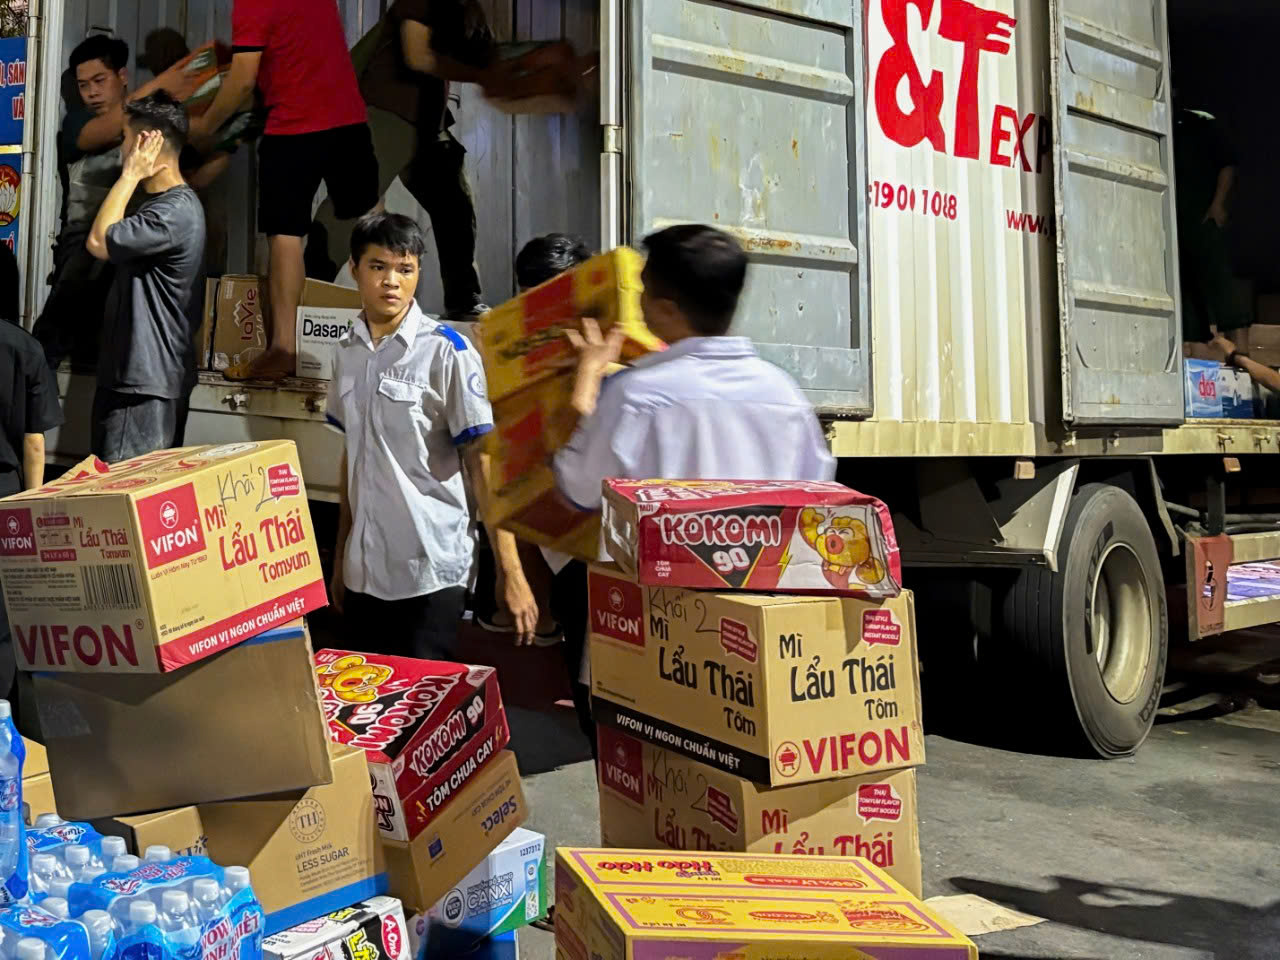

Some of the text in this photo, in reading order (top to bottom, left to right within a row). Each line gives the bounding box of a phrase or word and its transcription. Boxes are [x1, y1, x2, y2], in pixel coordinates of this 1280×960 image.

[303, 318, 350, 339] Dasan
[1, 536, 32, 550] VIFON
[101, 528, 128, 546] Thái
[150, 525, 198, 556] VIFON
[219, 508, 305, 571] Lẩu Thái
[661, 515, 781, 546] KOKOMI
[258, 549, 311, 584] Tomyum
[713, 548, 750, 575] 90
[189, 596, 305, 655] VIFON VỊ NGON CHUẨN VIỆT
[597, 610, 639, 637] VIFON
[650, 613, 669, 641] Mì
[695, 598, 721, 634] 2
[14, 624, 139, 667] VIFON
[780, 633, 803, 659] Mì
[659, 645, 754, 707] Lẩu Thái
[790, 654, 896, 702] Lẩu Thái
[349, 676, 458, 750] KOKOMI
[724, 707, 756, 737] Tôm
[864, 698, 898, 720] Tôm
[412, 695, 484, 776] KOKOMI 90
[617, 714, 741, 770] VIFON VỊ NGON CHUẨN VIỆT
[802, 726, 911, 774] VIFON
[426, 736, 494, 811] TÔM CHUA CAY
[606, 763, 640, 793] VIFON
[762, 809, 788, 835] Mì
[297, 847, 349, 873] LESS SUGAR
[468, 880, 513, 909] CANXI
